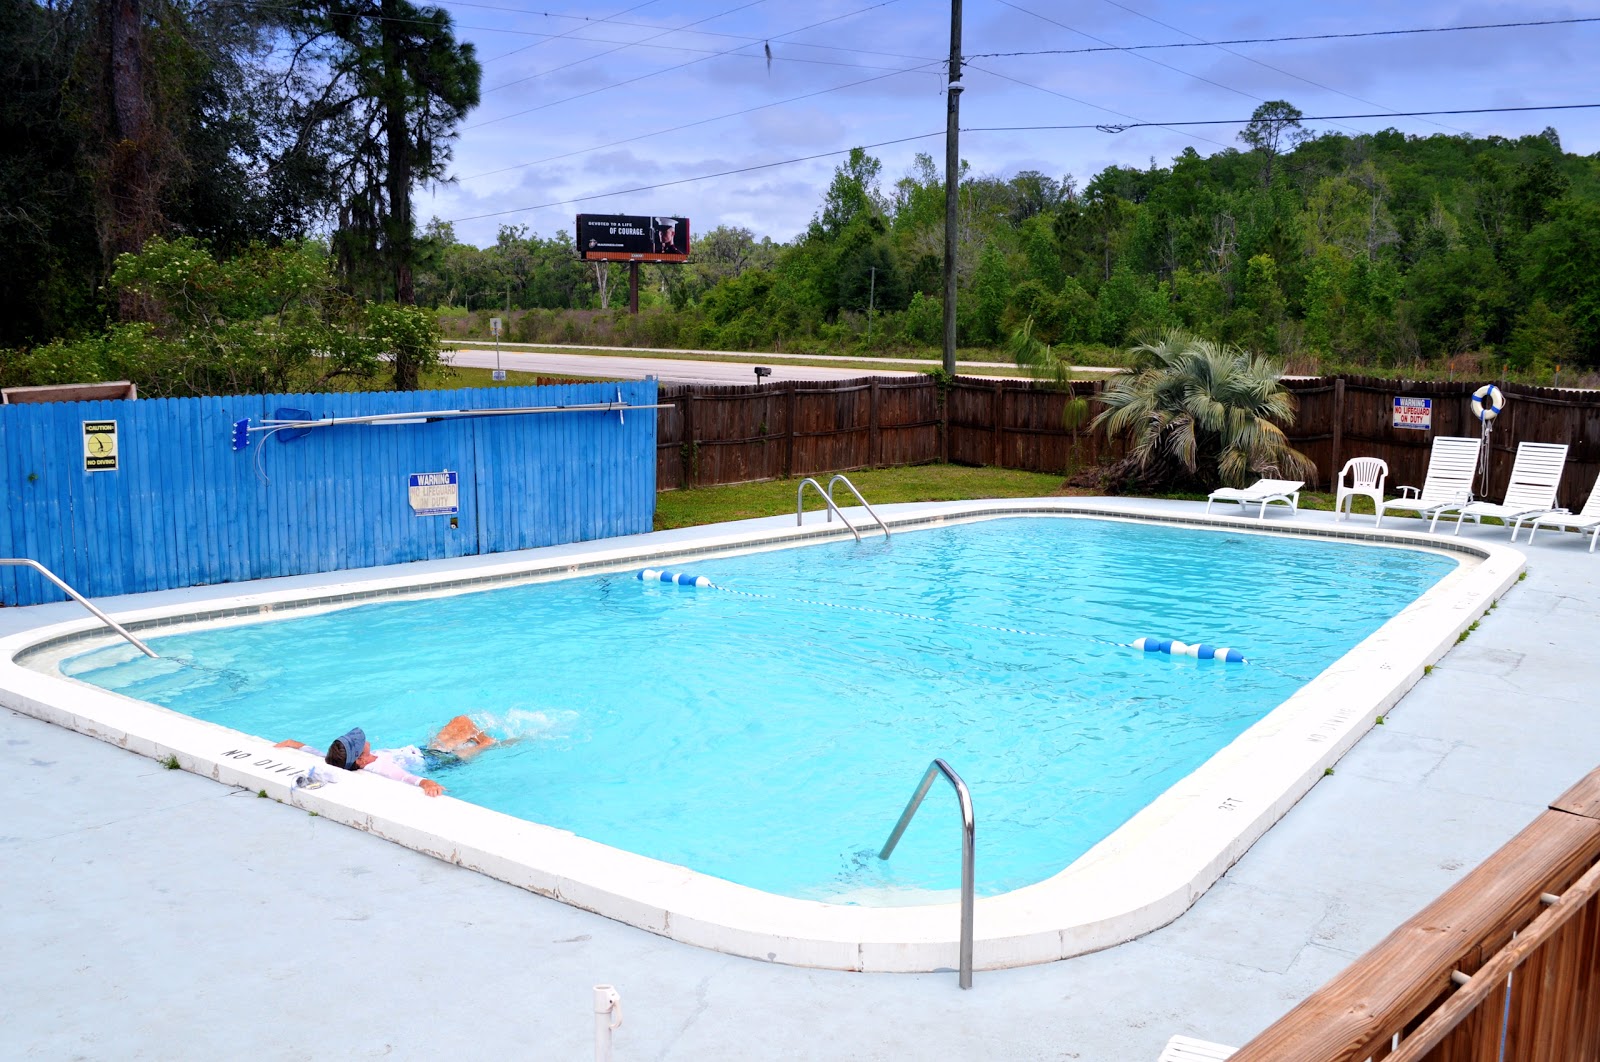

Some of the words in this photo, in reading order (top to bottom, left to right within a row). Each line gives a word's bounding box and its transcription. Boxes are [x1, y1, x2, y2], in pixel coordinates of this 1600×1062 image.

[1400, 398, 1425, 407] WARNING
[1404, 407, 1429, 415] LIFEGUARD
[417, 474, 450, 485] WARNING
[411, 487, 420, 497] NO
[423, 485, 455, 496] LIFEGUARD
[432, 496, 448, 506] DUTY
[221, 749, 252, 759] NO
[253, 759, 305, 776] DIVI
